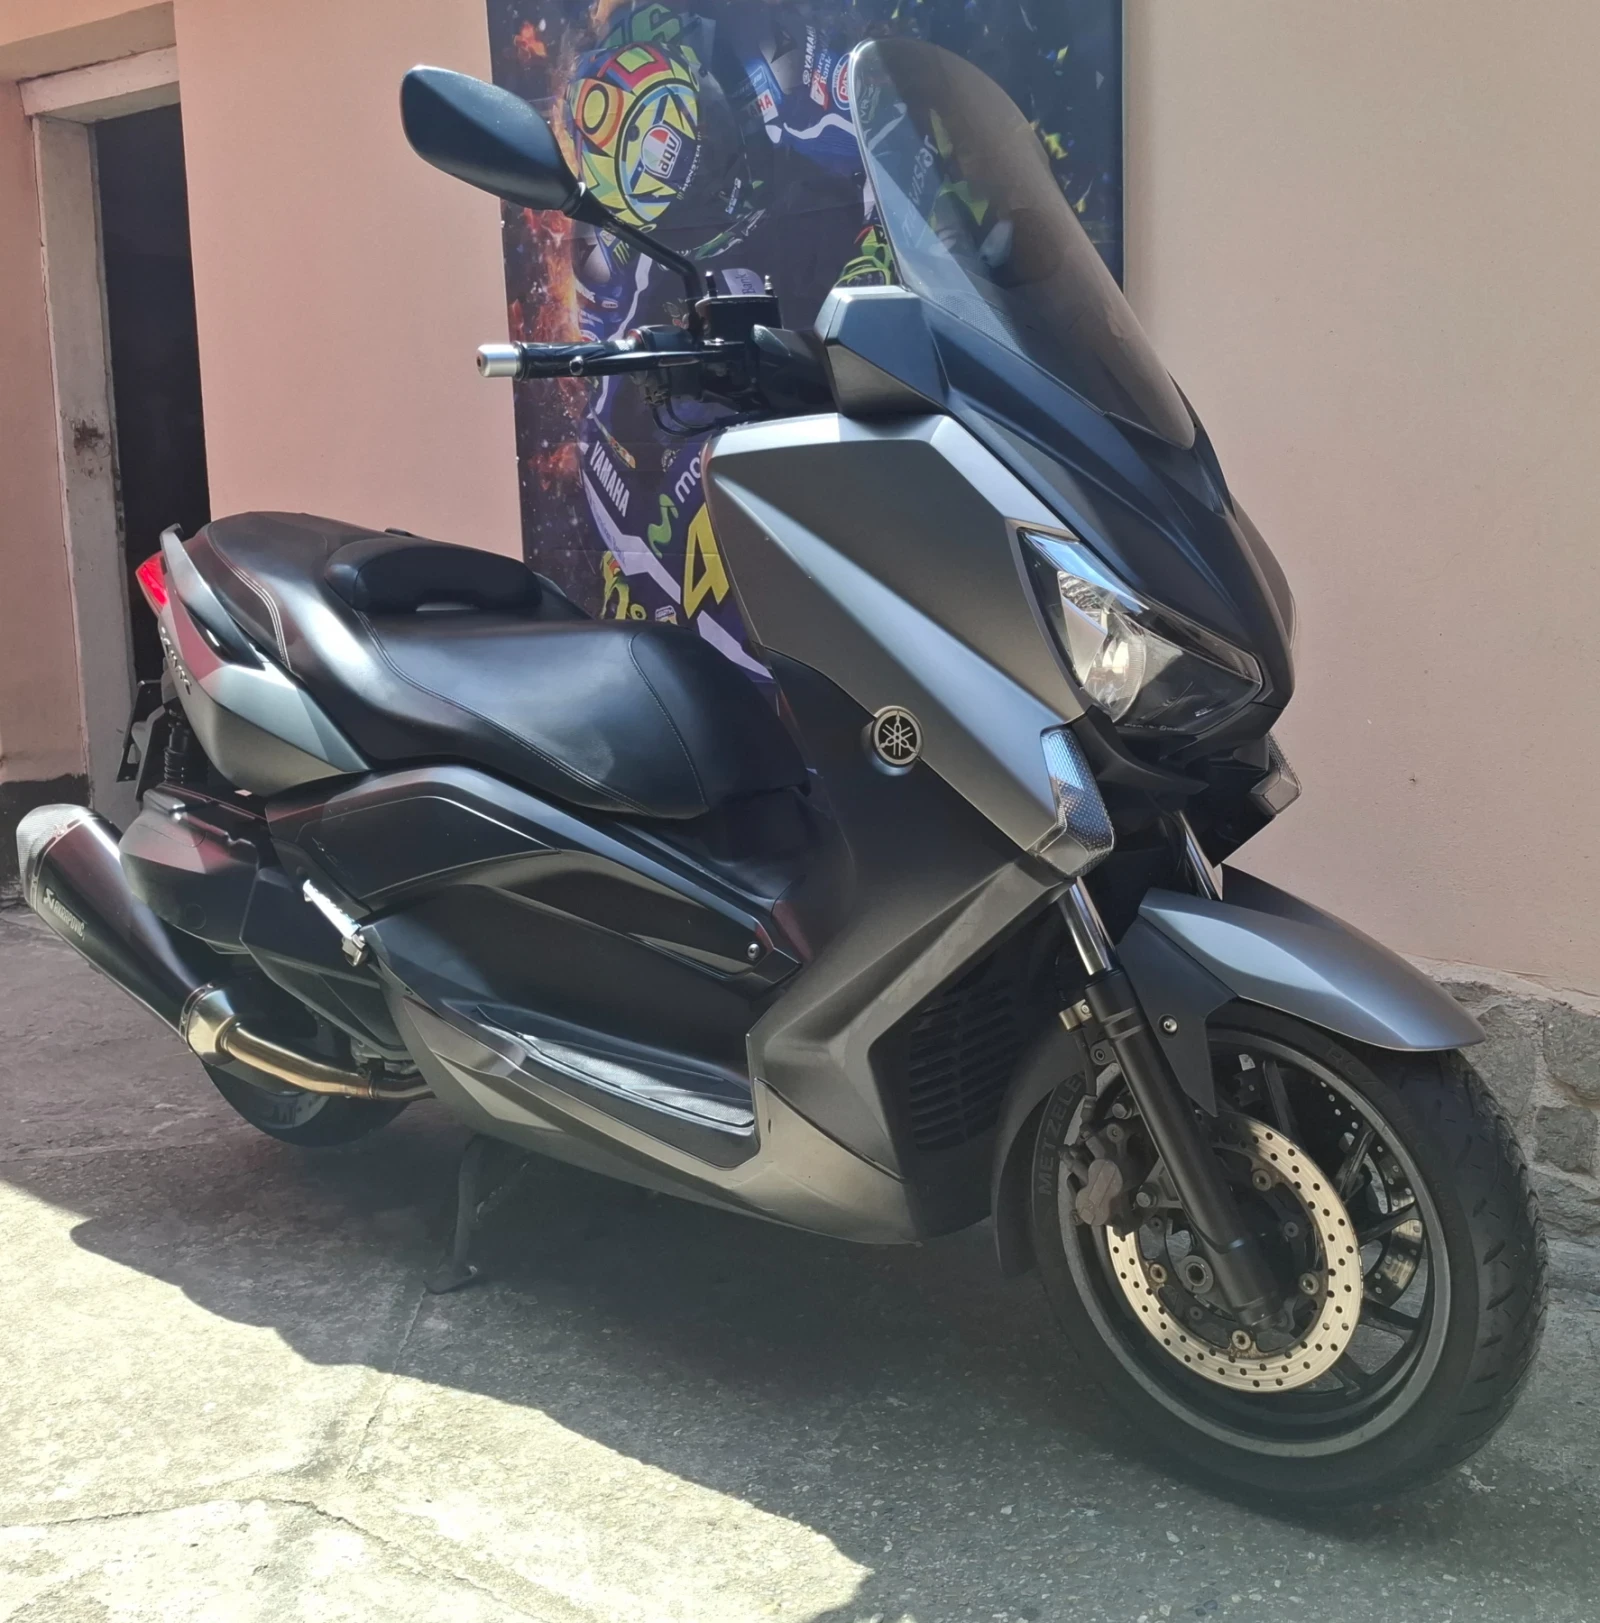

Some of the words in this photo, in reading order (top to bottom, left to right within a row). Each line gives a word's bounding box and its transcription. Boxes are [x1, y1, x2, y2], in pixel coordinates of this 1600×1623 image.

[820, 56, 832, 84] Bank
[658, 136, 678, 173] agv
[681, 144, 702, 192] MONSTER
[590, 440, 630, 518] YAMAHA
[674, 452, 702, 503] mo
